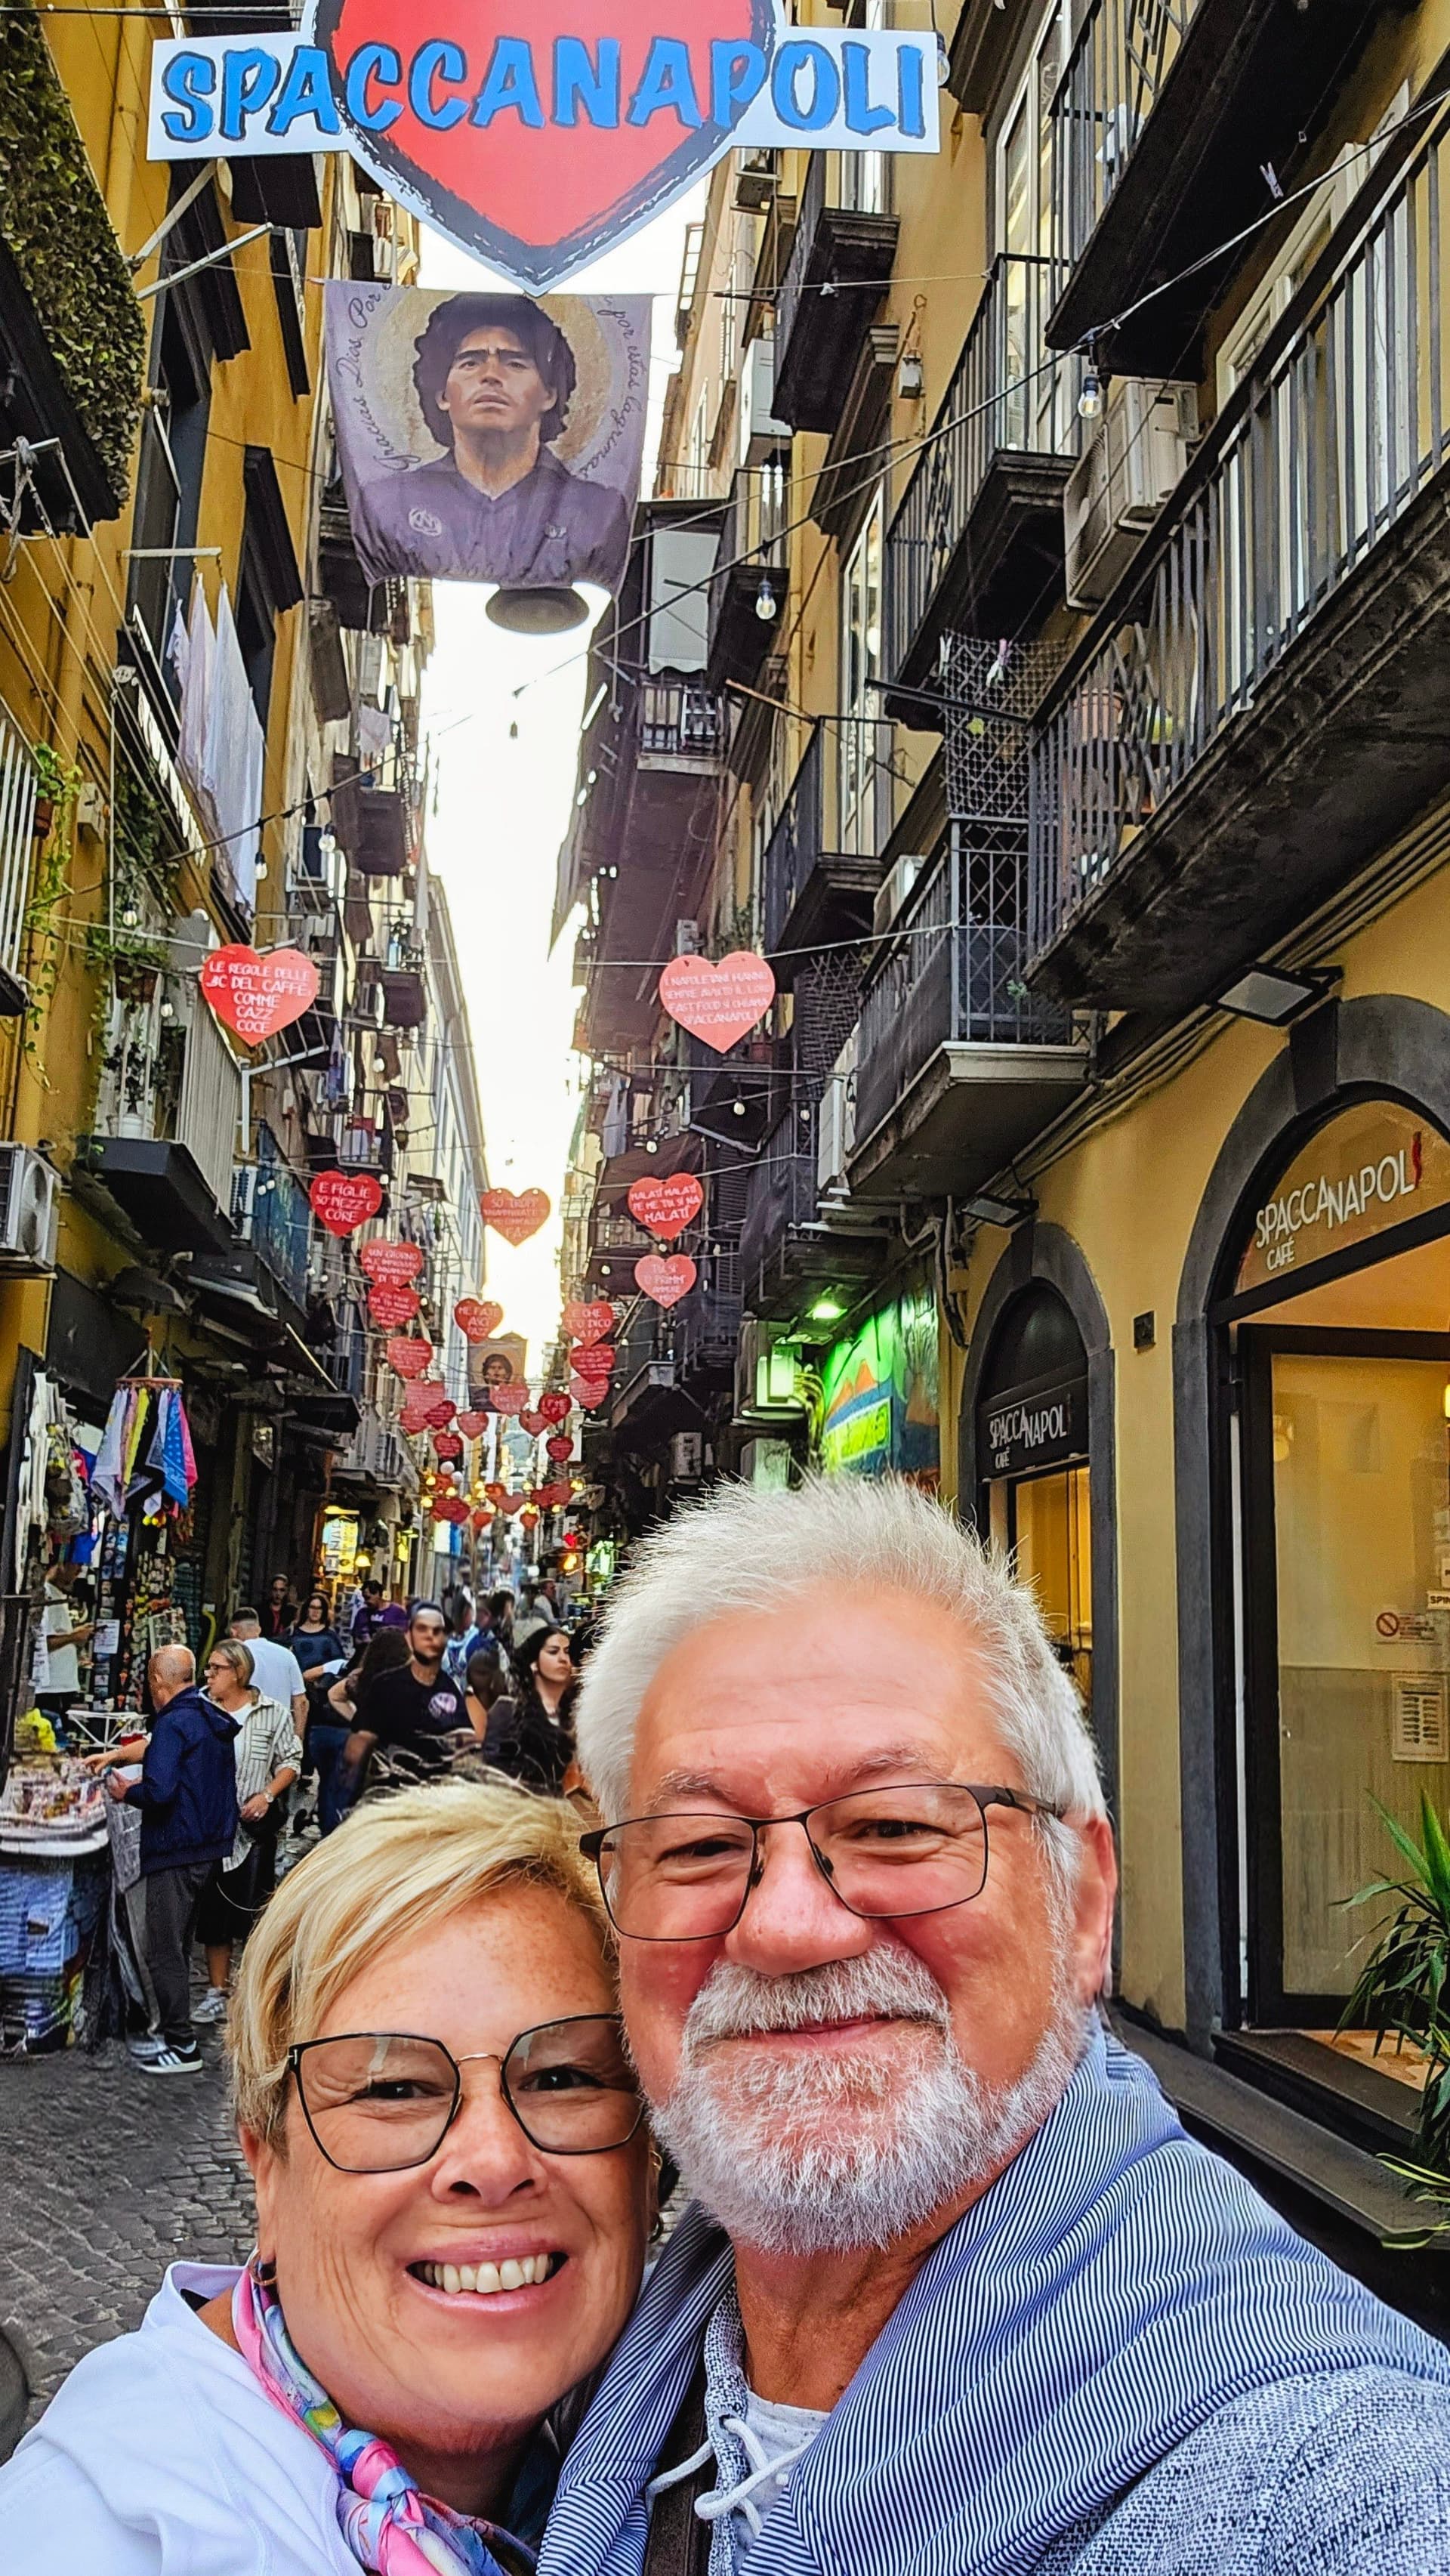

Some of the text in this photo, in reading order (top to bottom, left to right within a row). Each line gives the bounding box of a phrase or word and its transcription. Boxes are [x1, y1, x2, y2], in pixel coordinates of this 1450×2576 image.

[161, 36, 926, 143] SPACCANAPOLI
[208, 960, 310, 981] LE REGOLE DELLE
[231, 977, 258, 991] DEL
[233, 991, 281, 1008] COMME
[236, 1006, 274, 1020] CAZZ
[236, 1020, 270, 1035] COCE
[331, 1181, 372, 1200] FIGLIE
[1256, 1131, 1422, 1249] SPACCANAPOLI
[325, 1207, 359, 1224] CORE
